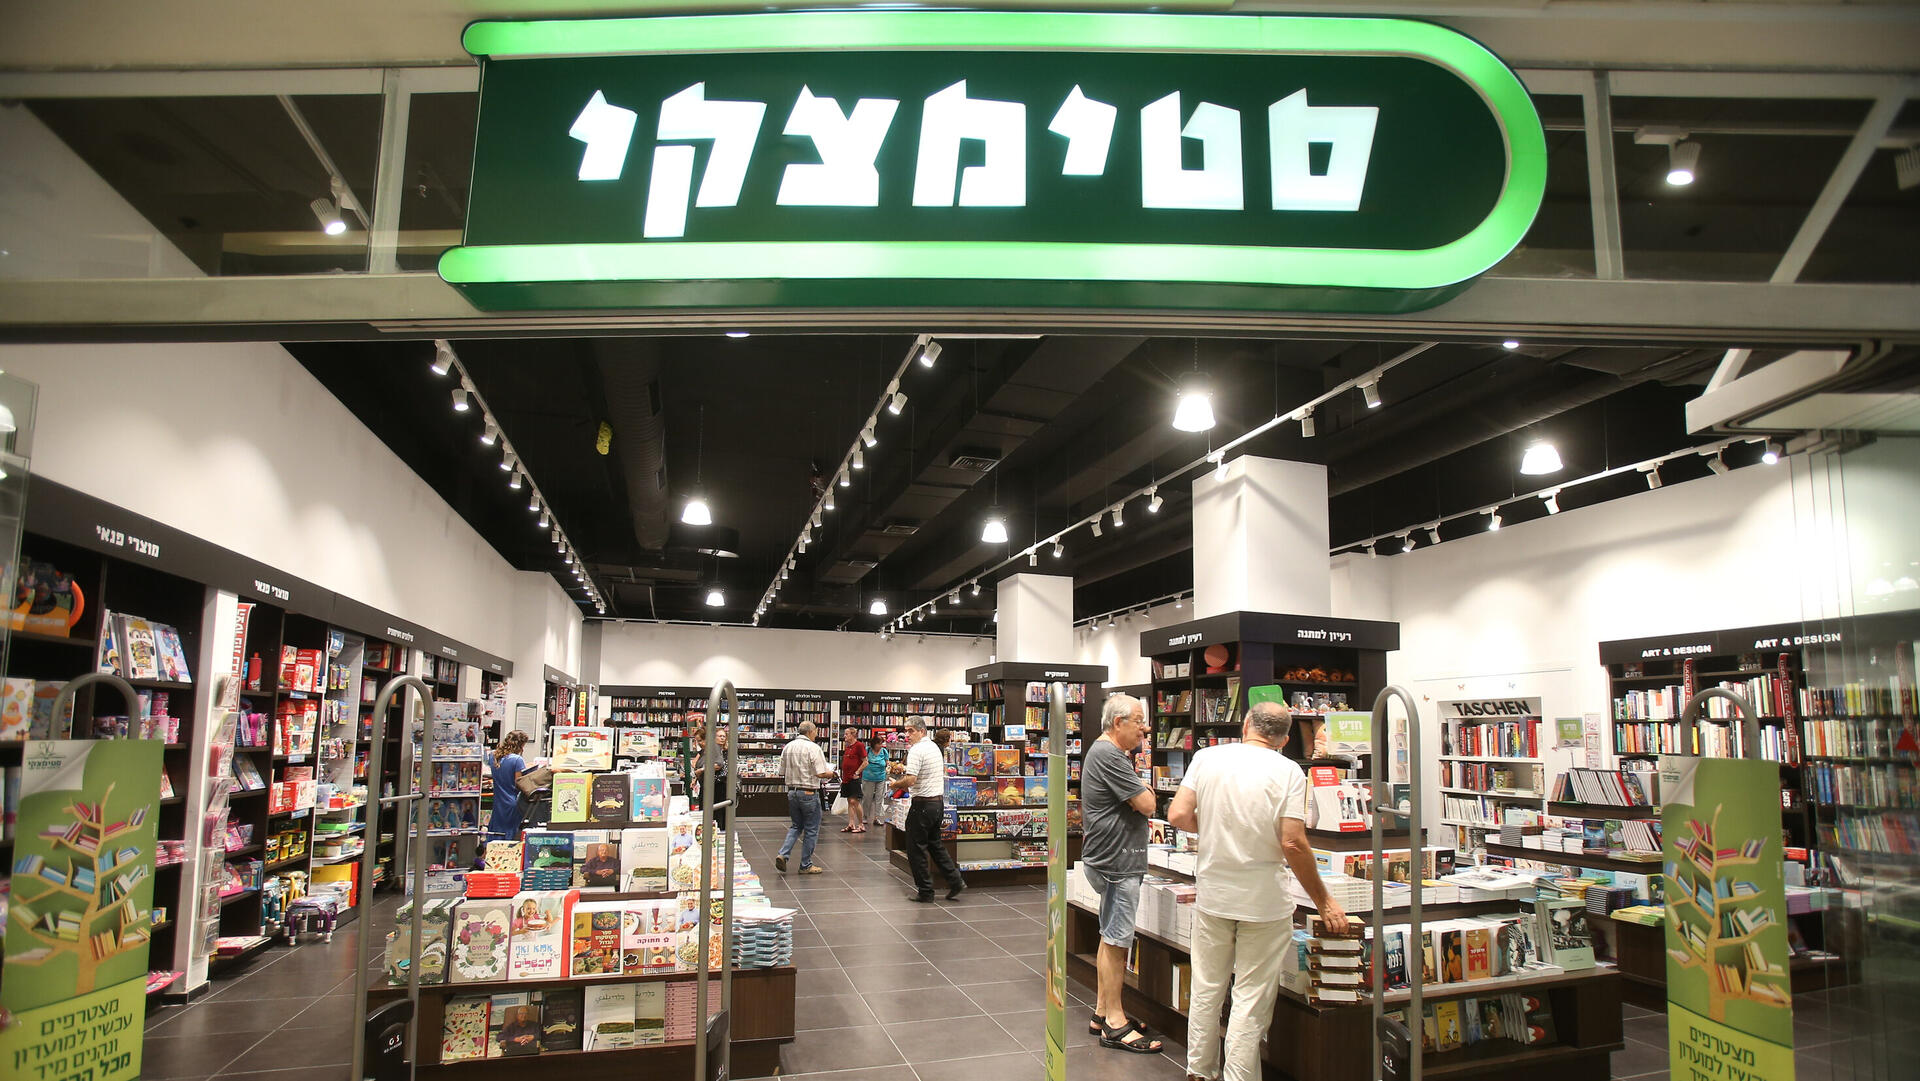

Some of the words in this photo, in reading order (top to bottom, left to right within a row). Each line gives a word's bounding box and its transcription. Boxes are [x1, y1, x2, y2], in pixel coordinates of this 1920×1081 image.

[568, 80, 1379, 238] סטימצקי
[96, 525, 125, 546] פנאי
[128, 535, 160, 558] מוצרי
[255, 579, 271, 595] פנאי
[271, 585, 290, 601] מוצרי
[1168, 635, 1187, 646] למתנה
[1187, 633, 1203, 645] רעיון
[1297, 629, 1327, 640] למתנה
[1329, 631, 1352, 642] רעיון
[1754, 639, 1779, 649] ART
[1780, 638, 1791, 646] &
[1794, 633, 1841, 646] DESIGN
[1641, 649, 1662, 658] ART
[1663, 648, 1671, 656] &
[1672, 645, 1712, 656] DESIGN
[1452, 700, 1532, 716] TASCHEN
[1338, 720, 1363, 731] חדש
[574, 738, 587, 747] 30
[533, 943, 553, 952] אמא
[41, 998, 120, 1036] מצטרפים
[92, 1013, 133, 1041] עכשיו
[13, 1029, 88, 1071] למועדון
[72, 1038, 118, 1068] ונהנים
[1689, 1026, 1755, 1067] מצטרפים
[99, 1051, 132, 1078] מכל
[1678, 1040, 1723, 1075] למועדון
[33, 1057, 68, 1080] מיד
[1726, 1063, 1768, 1081] שיו
